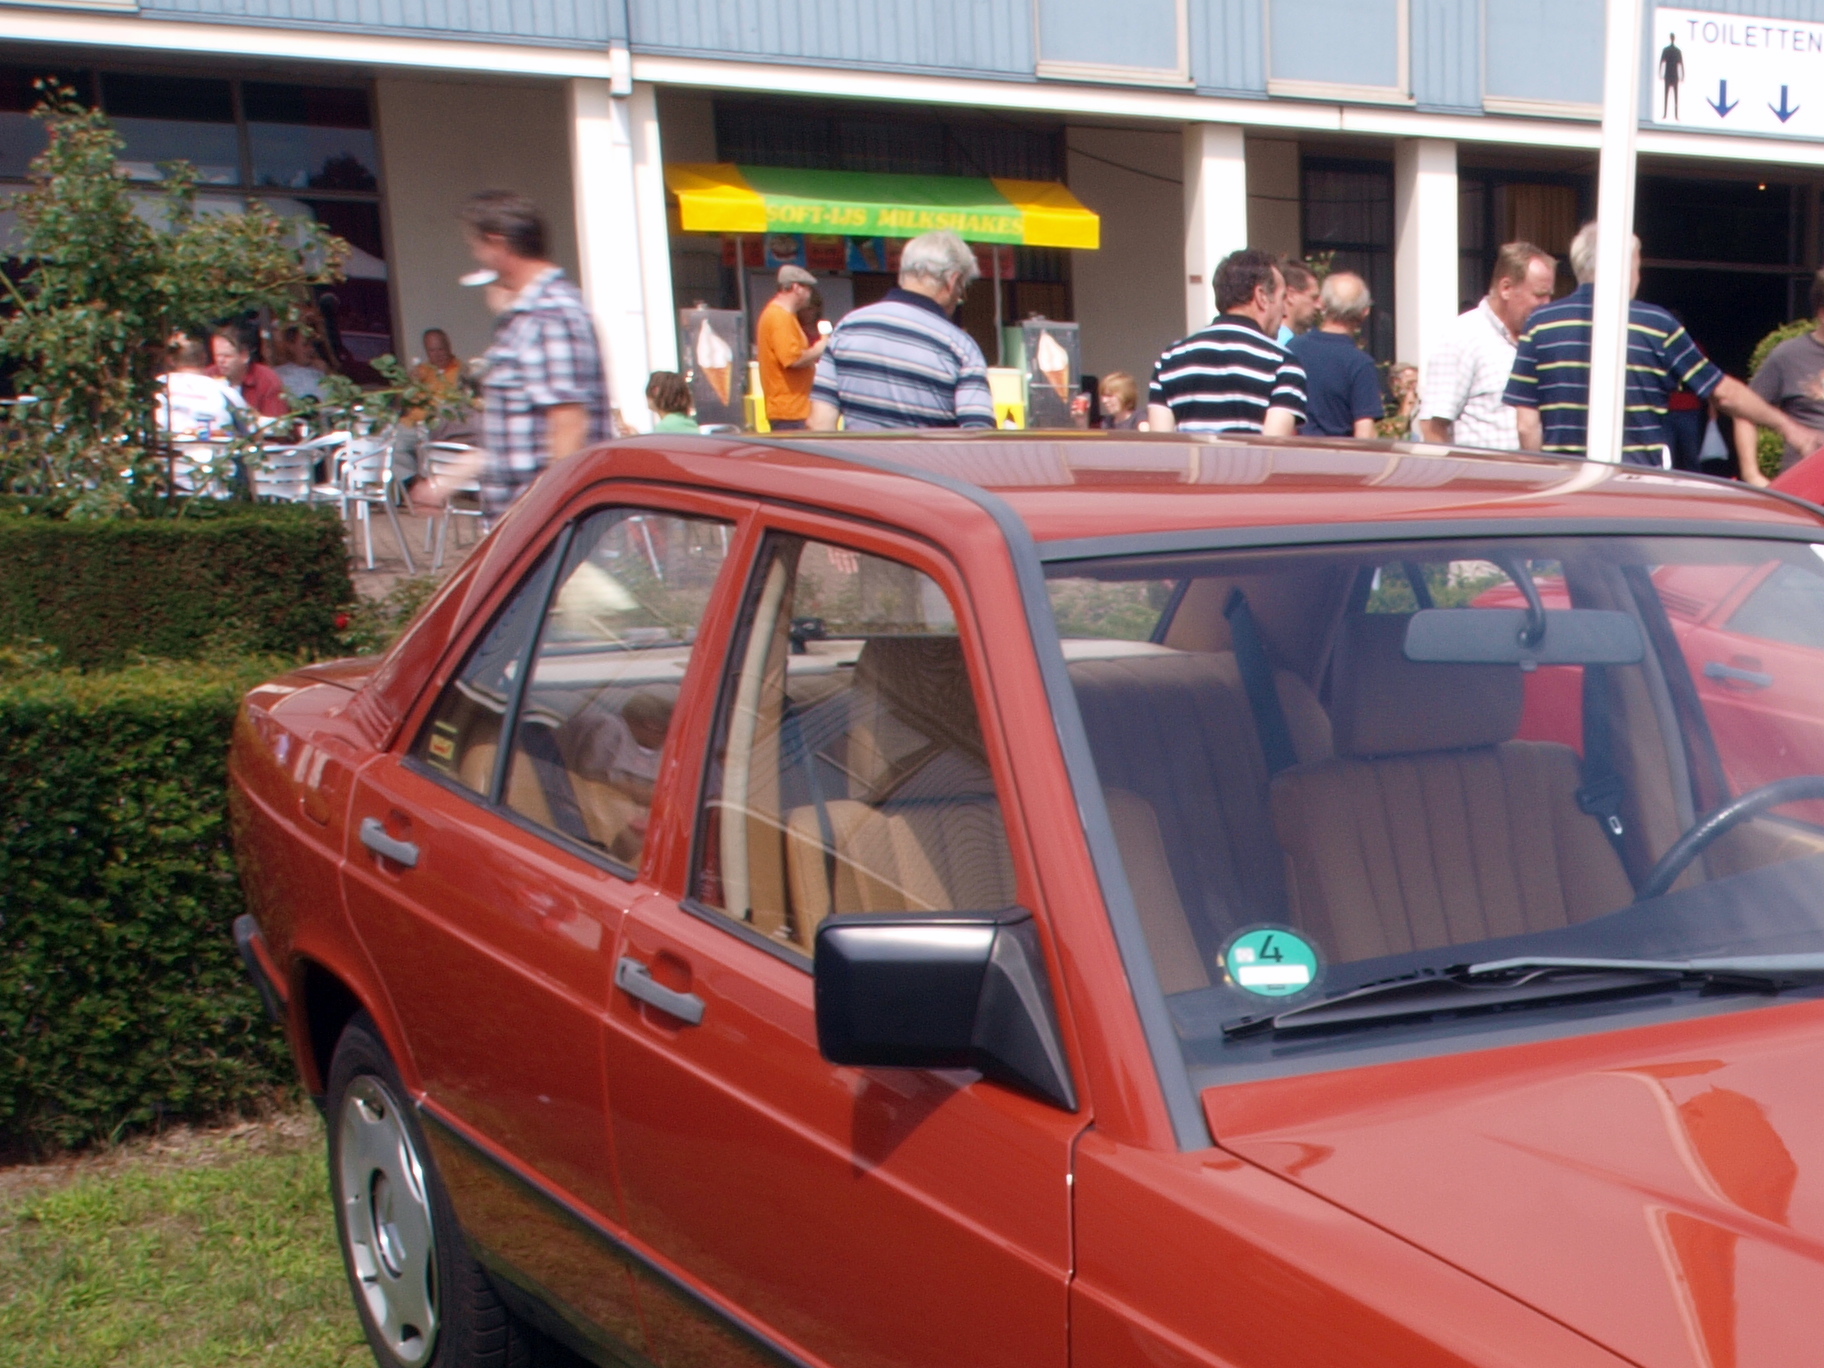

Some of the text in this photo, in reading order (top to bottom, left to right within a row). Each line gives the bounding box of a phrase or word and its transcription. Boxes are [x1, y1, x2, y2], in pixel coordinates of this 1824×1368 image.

[1687, 20, 1823, 53] TOILETTEN
[766, 203, 1025, 235] SOFT-IJS MILKSHAKES
[1258, 934, 1284, 963] 4
